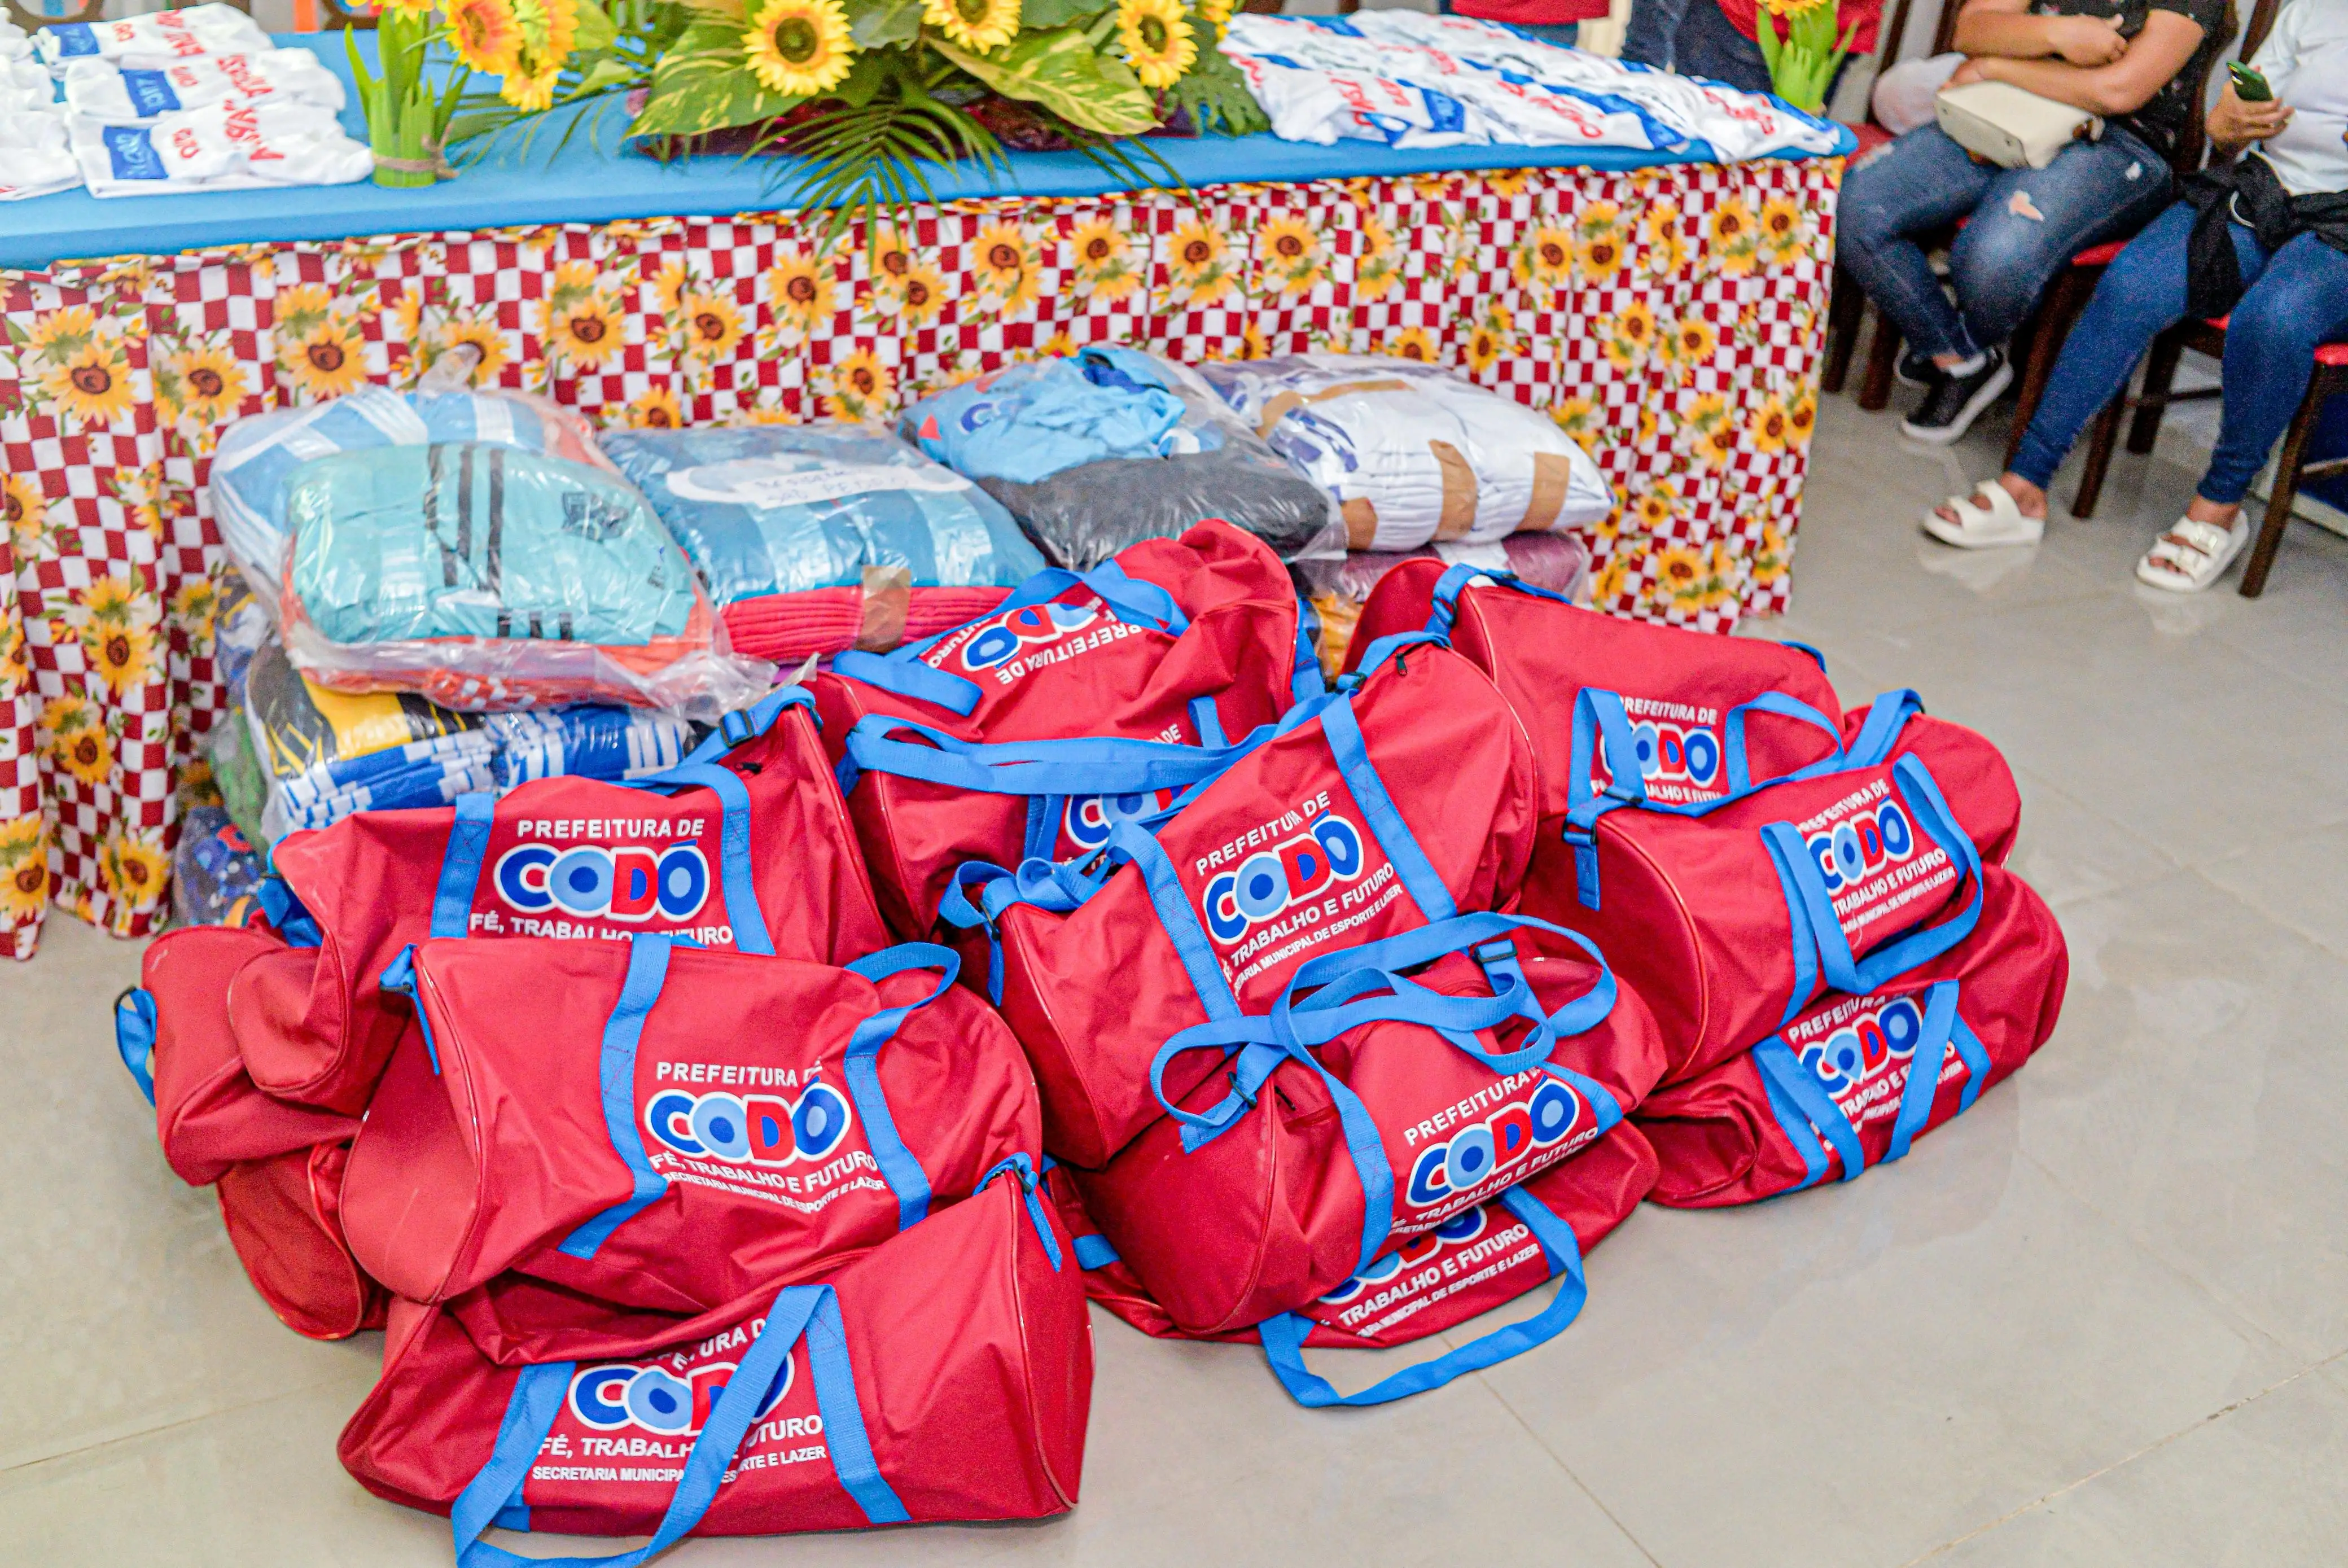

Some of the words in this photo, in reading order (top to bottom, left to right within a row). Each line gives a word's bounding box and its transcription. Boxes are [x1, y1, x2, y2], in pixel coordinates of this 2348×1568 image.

[995, 663, 1025, 684] DE
[1697, 707, 1718, 725] DE
[1600, 720, 1720, 788] ODÓ
[1870, 778, 1890, 798] DE
[1302, 790, 1330, 818] DE
[517, 819, 671, 838] PREFEITURA
[676, 818, 706, 836] DE
[1833, 878, 1888, 917] TRABALHO
[1886, 873, 1898, 890] E
[1895, 848, 1947, 885] FUTURO
[1230, 905, 1320, 967] TRABALHO
[1324, 898, 1339, 916] E
[1341, 862, 1395, 909] FUTURO
[1259, 936, 1315, 970] MUNICIPAL
[1313, 927, 1331, 942] DE
[1330, 905, 1376, 935] ESPORTE
[656, 1061, 798, 1088] PREFEITURA
[1404, 1071, 1531, 1146] PREFEITURA
[662, 1171, 731, 1192] SECRETARIA
[839, 1182, 850, 1195] E
[683, 1158, 786, 1189] TRABALHO
[786, 1176, 802, 1194] E
[804, 1150, 878, 1193] FUTURO
[1416, 1172, 1513, 1221] TRABALHO
[1515, 1163, 1528, 1177] E
[1531, 1127, 1598, 1170] FUTURO
[1497, 1259, 1507, 1273] E
[1505, 1243, 1540, 1269] LAZER
[1338, 1269, 1441, 1326] TRABALHO
[1440, 1258, 1459, 1278] E
[1456, 1224, 1529, 1269] FUTURO
[751, 1318, 766, 1339] D
[581, 1438, 696, 1458] TRABALH
[532, 1466, 618, 1481] SECRETARIA
[620, 1468, 684, 1482] MUNICIP
[767, 1453, 779, 1466] E
[781, 1445, 827, 1465] LAZER
